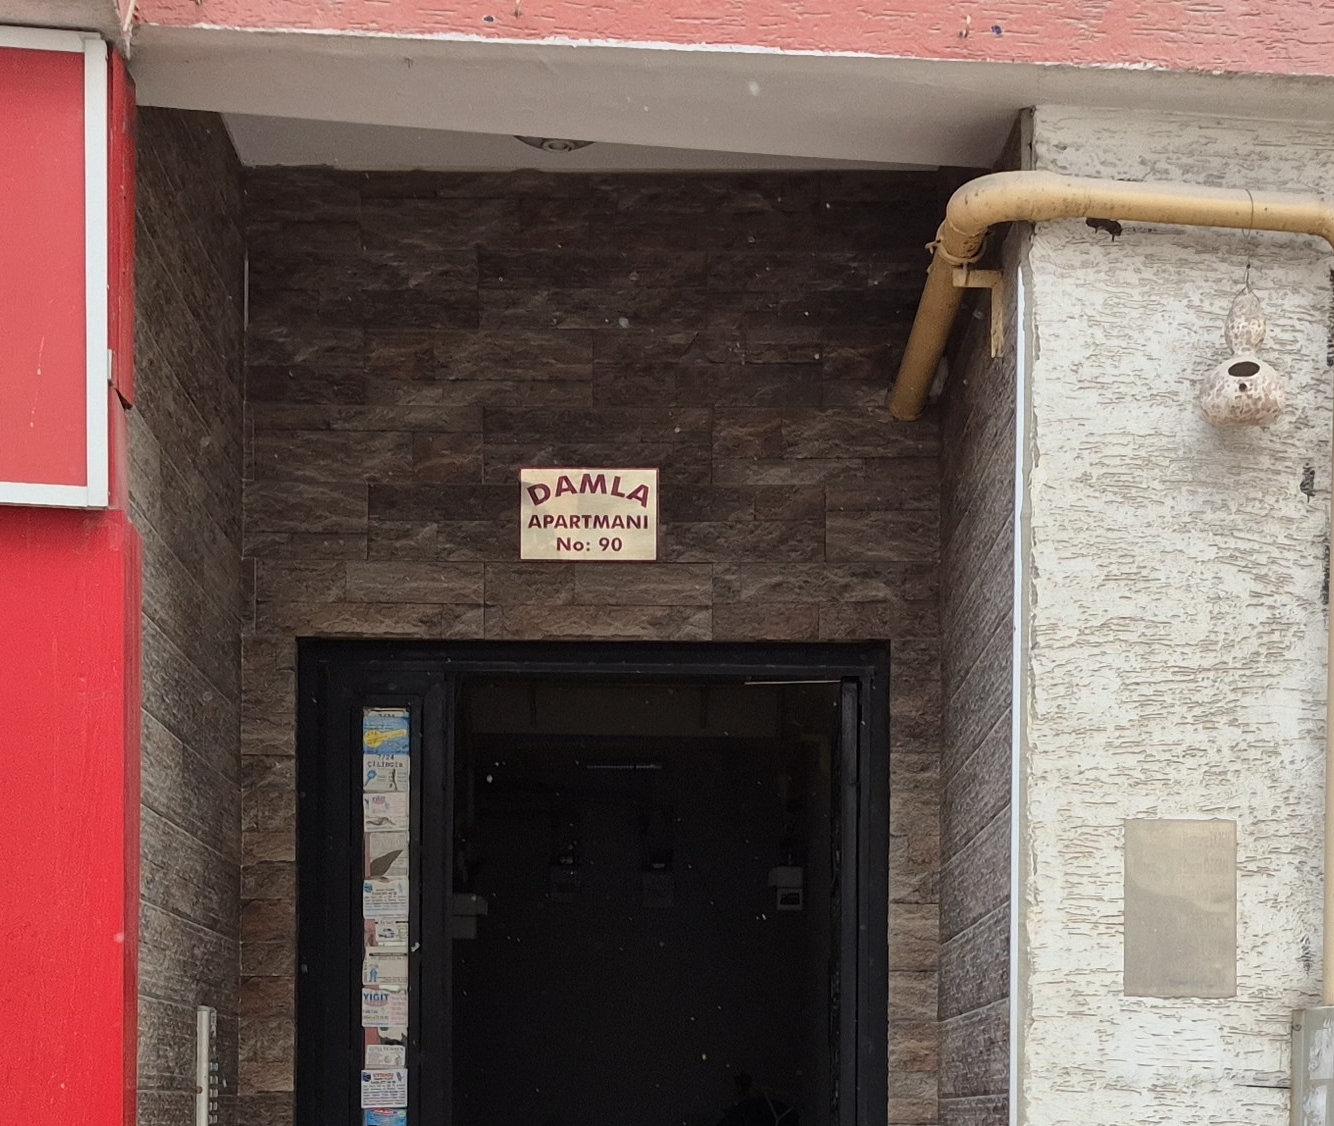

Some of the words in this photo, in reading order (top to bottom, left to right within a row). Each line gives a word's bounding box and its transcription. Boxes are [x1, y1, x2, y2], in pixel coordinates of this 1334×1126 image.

[527, 473, 649, 508] DAMLA
[528, 514, 648, 530] APARTMANI
[556, 537, 591, 552] No:
[598, 537, 623, 552] 90
